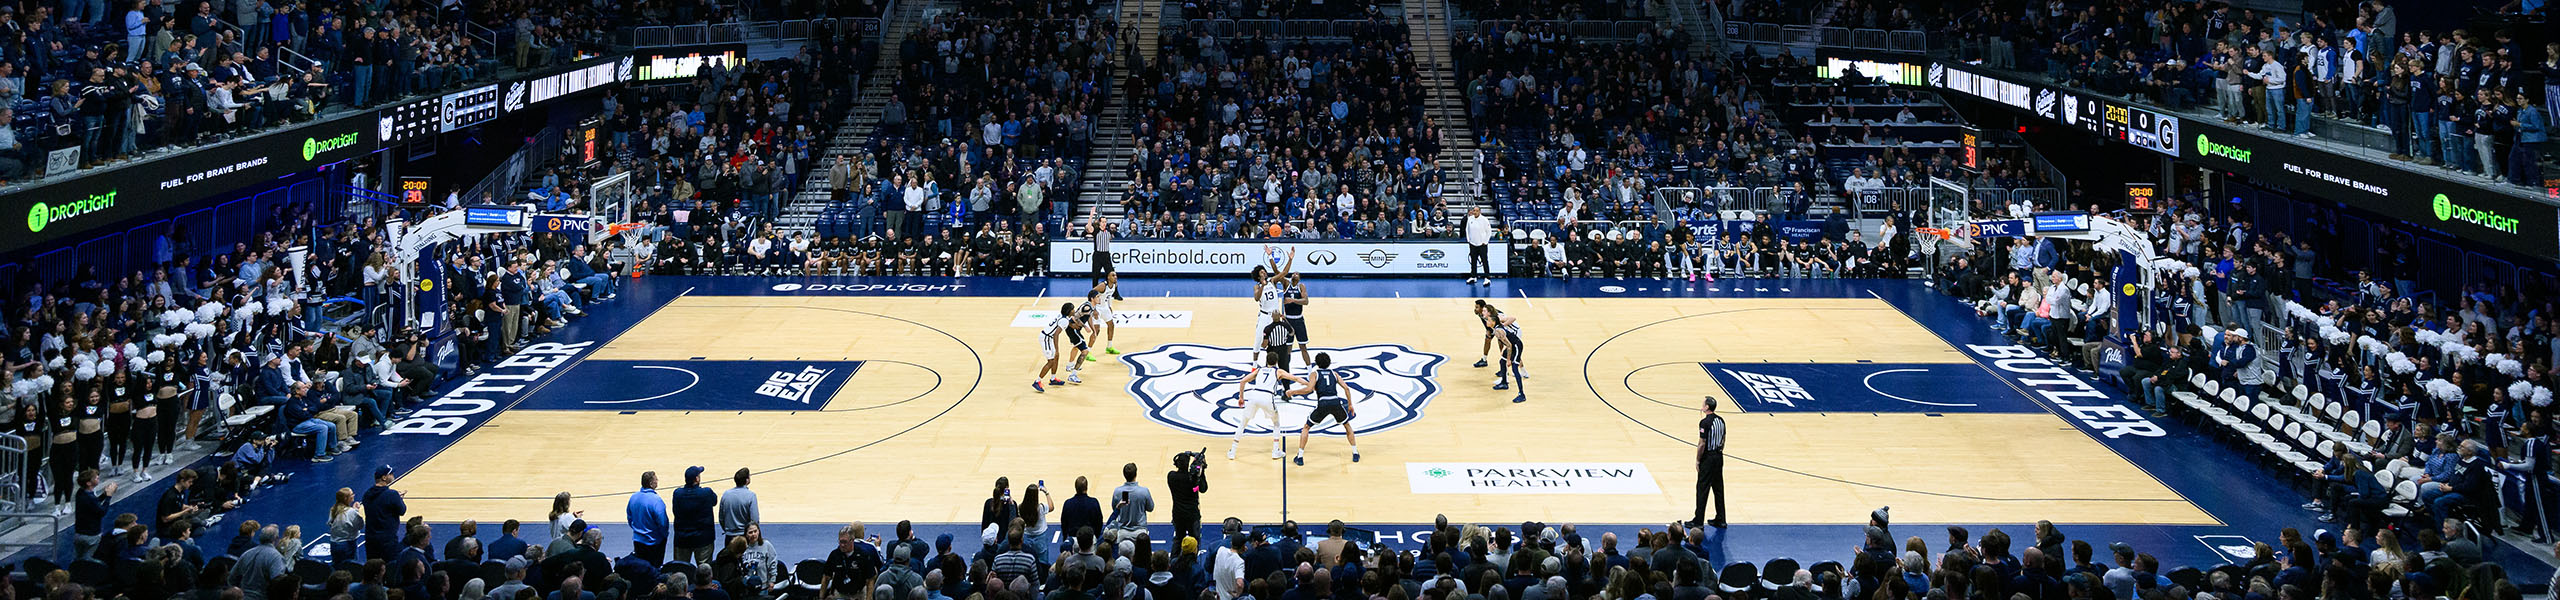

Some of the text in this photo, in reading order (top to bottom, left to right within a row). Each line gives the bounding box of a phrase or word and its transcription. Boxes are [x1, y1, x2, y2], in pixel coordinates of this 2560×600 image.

[560, 72, 568, 96] AT
[1972, 73, 1980, 96] AT
[444, 102, 453, 125] G
[2088, 100, 2096, 115] 0
[2105, 104, 2128, 125] 20:00
[2140, 113, 2147, 129] 0
[2158, 118, 2175, 152] G
[584, 140, 594, 163] 30
[1965, 146, 1976, 168] 30
[160, 156, 268, 190] FUEL FOR BRAVE BRANDS
[2283, 163, 2388, 196] FUEL FOR BRAVE BRANDS
[402, 181, 427, 190] 20:00
[2129, 188, 2153, 197] 20:00
[408, 191, 422, 202] 30
[1864, 194, 1877, 204] 108
[2135, 197, 2148, 209] 30
[563, 220, 589, 230] PNC
[1981, 224, 2010, 235] PNC
[1072, 249, 1245, 264] DrerReinbold.com
[1264, 291, 1275, 301] 13
[379, 340, 595, 436] BUTLER
[754, 370, 796, 397] BIG
[777, 365, 826, 401] EAST
[1262, 373, 1270, 383] 7
[1324, 374, 1330, 386] 1
[1738, 370, 1795, 407] EAST
[1765, 374, 1815, 400] BIG
[1965, 344, 2167, 439] BUTLER
[1466, 468, 1634, 478] PARKVIEW
